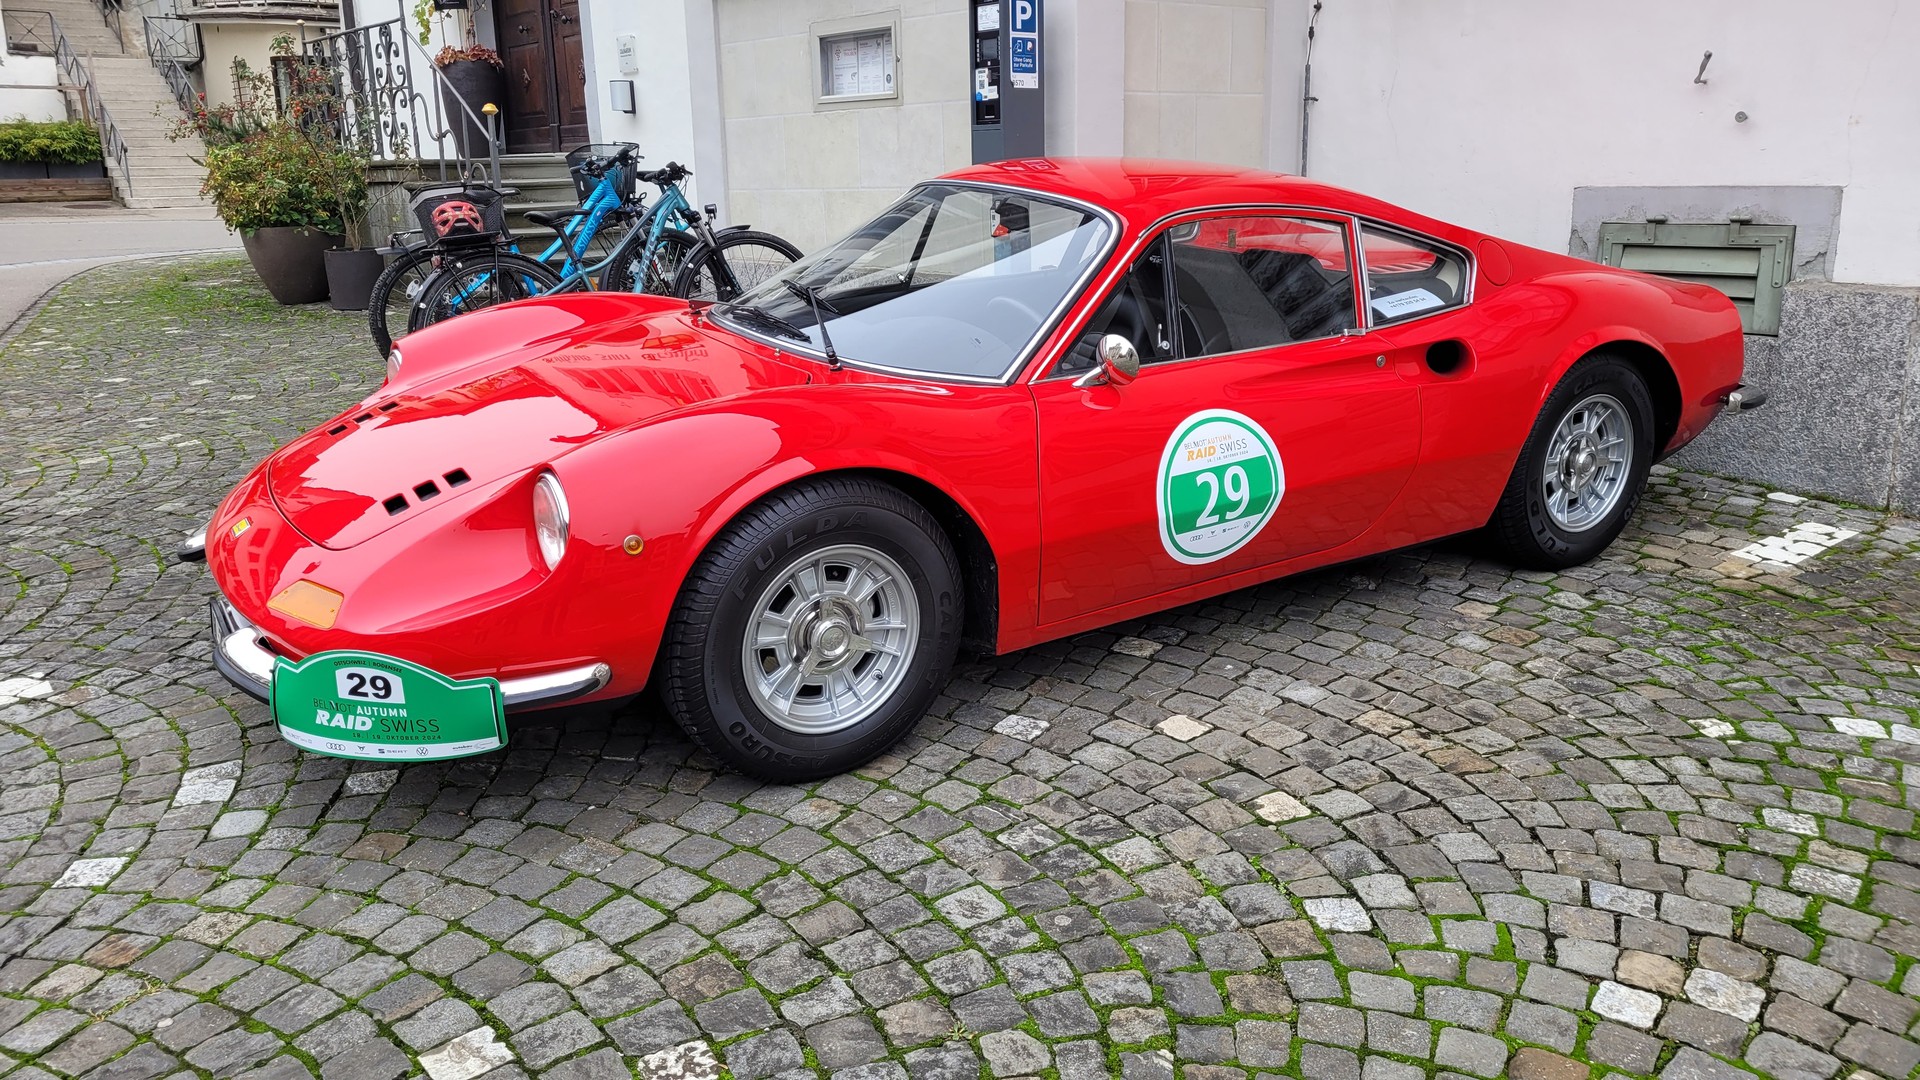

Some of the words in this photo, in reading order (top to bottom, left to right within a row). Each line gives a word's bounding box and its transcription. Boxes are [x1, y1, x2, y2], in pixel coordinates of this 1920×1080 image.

[1015, 0, 1032, 29] P
[1187, 445, 1217, 461] RAID
[1219, 438, 1248, 454] SWISS
[1207, 433, 1232, 445] AUTUMN
[1196, 465, 1251, 527] 29
[731, 510, 870, 601] FULDA
[372, 661, 402, 673] BODENSEE
[346, 672, 393, 700] 29
[315, 710, 373, 731] RAID
[381, 718, 440, 733] SWISS
[356, 705, 408, 718] AUTUMN
